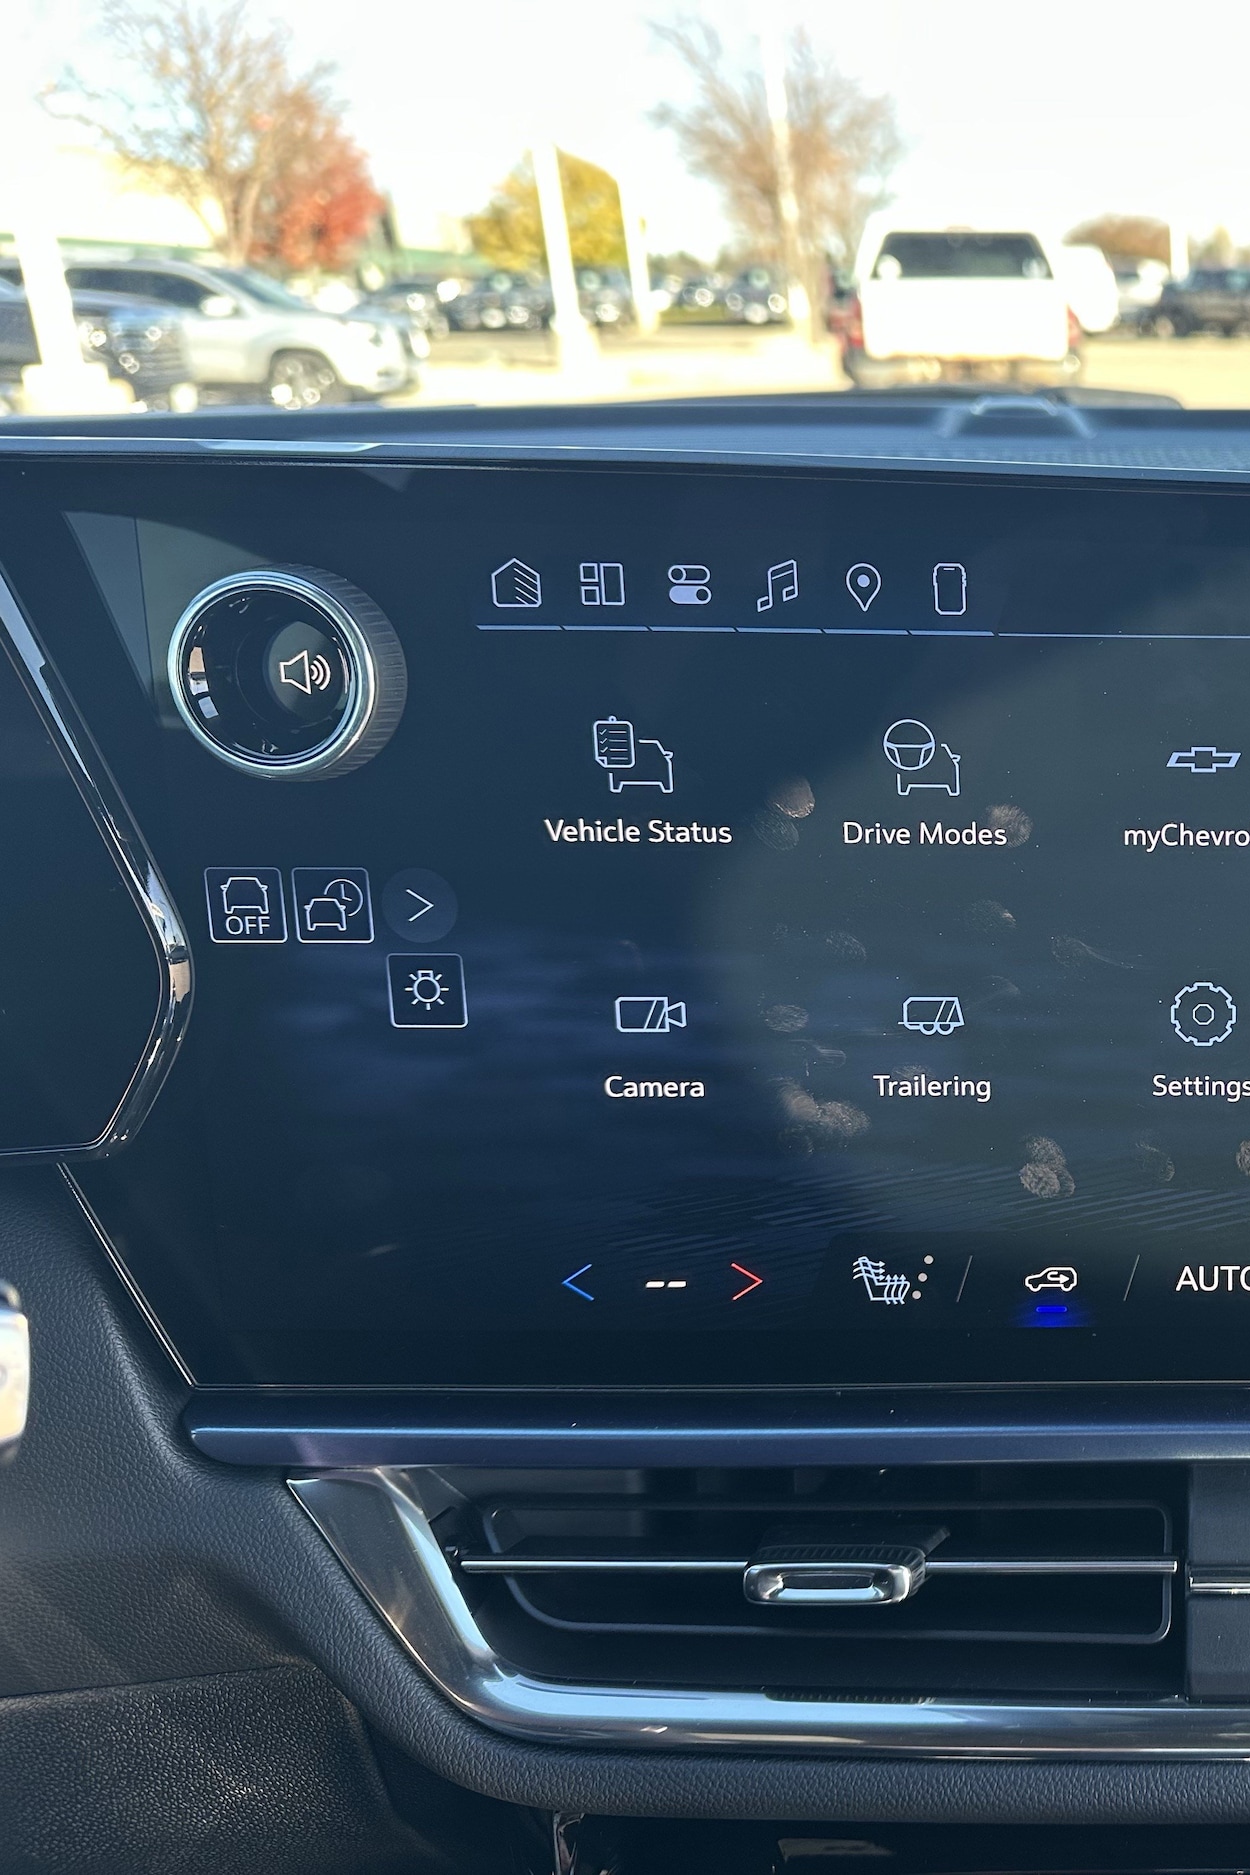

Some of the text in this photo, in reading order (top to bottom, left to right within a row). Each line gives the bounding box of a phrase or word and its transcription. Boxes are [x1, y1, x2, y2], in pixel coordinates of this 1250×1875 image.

[543, 818, 733, 844] Vehicle Status
[843, 821, 1008, 846] Drive Modes
[224, 916, 271, 935] OFF
[604, 1075, 705, 1098] Camera
[872, 1073, 991, 1103] Trailering
